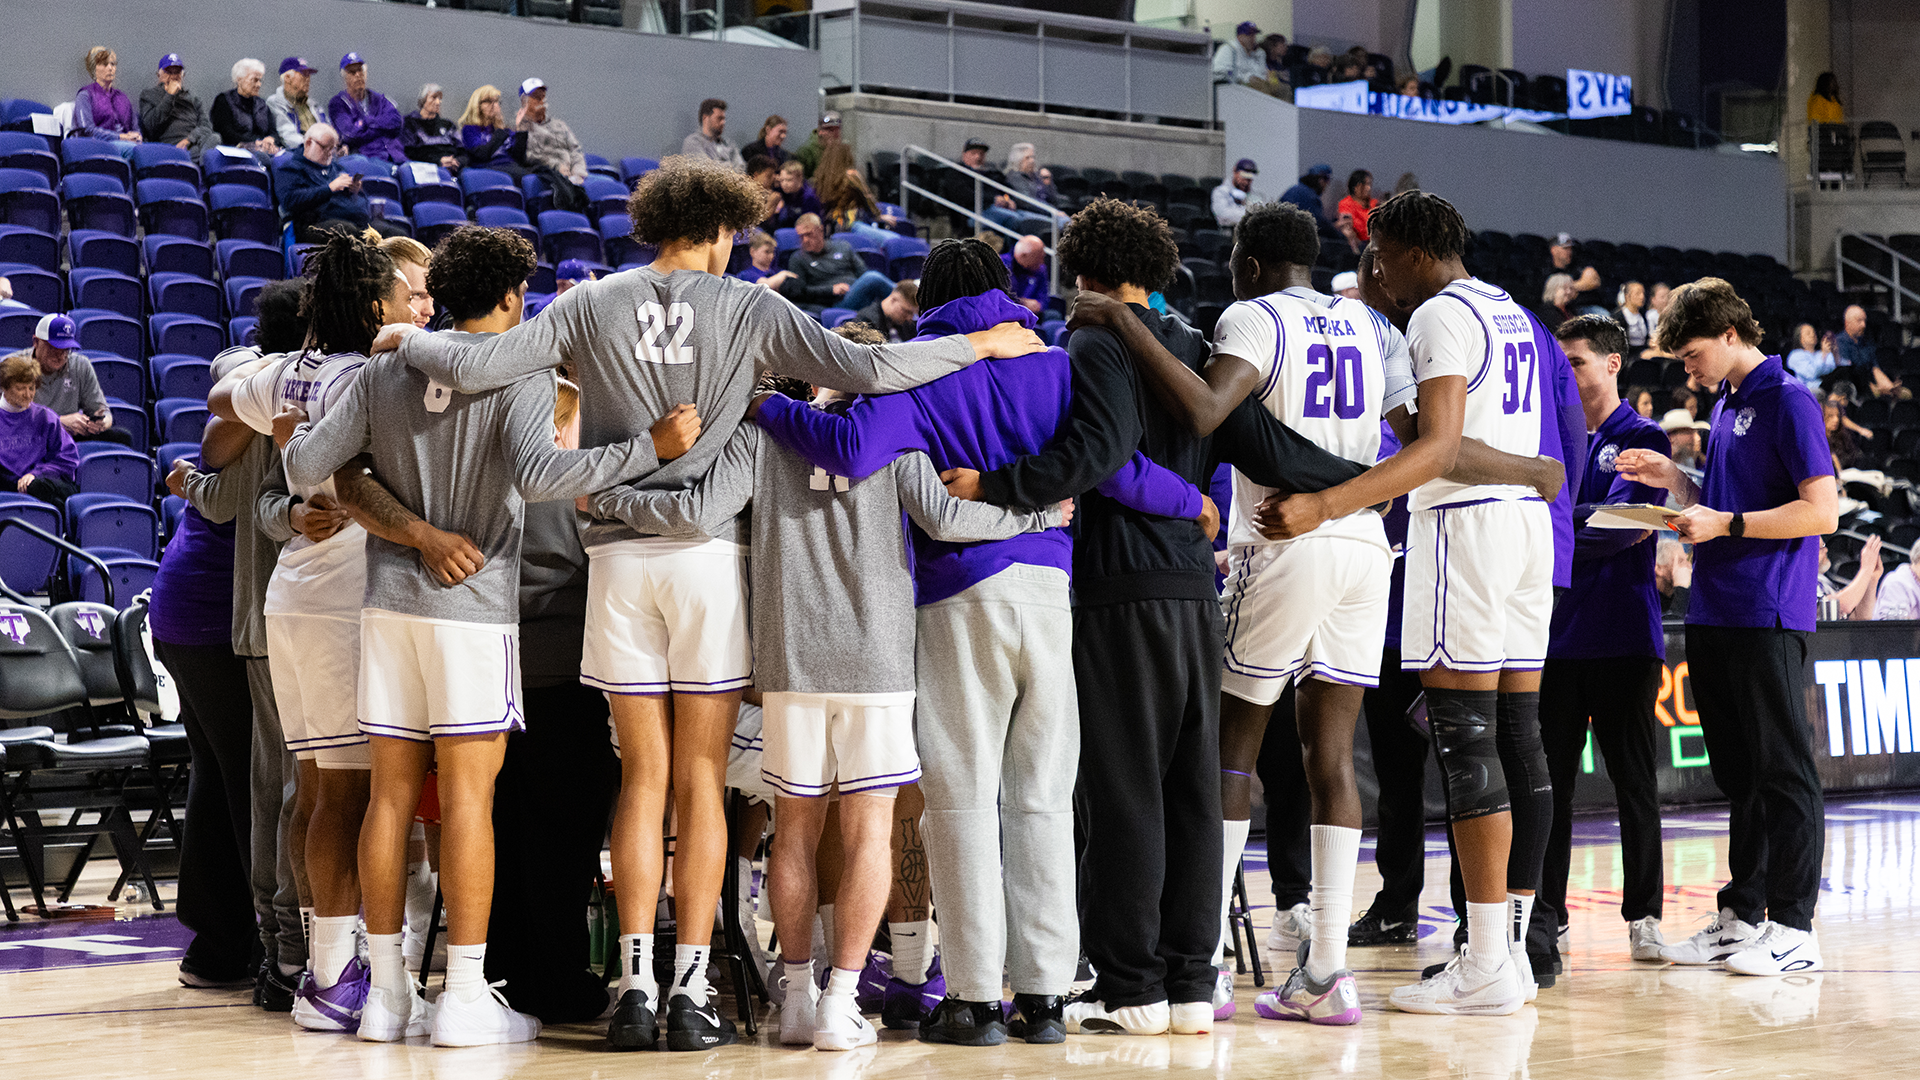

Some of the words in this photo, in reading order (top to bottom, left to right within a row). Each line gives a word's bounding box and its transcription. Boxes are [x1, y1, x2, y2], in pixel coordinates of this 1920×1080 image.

[635, 300, 695, 364] 22
[1302, 343, 1366, 420] 20
[1502, 341, 1536, 415] 97
